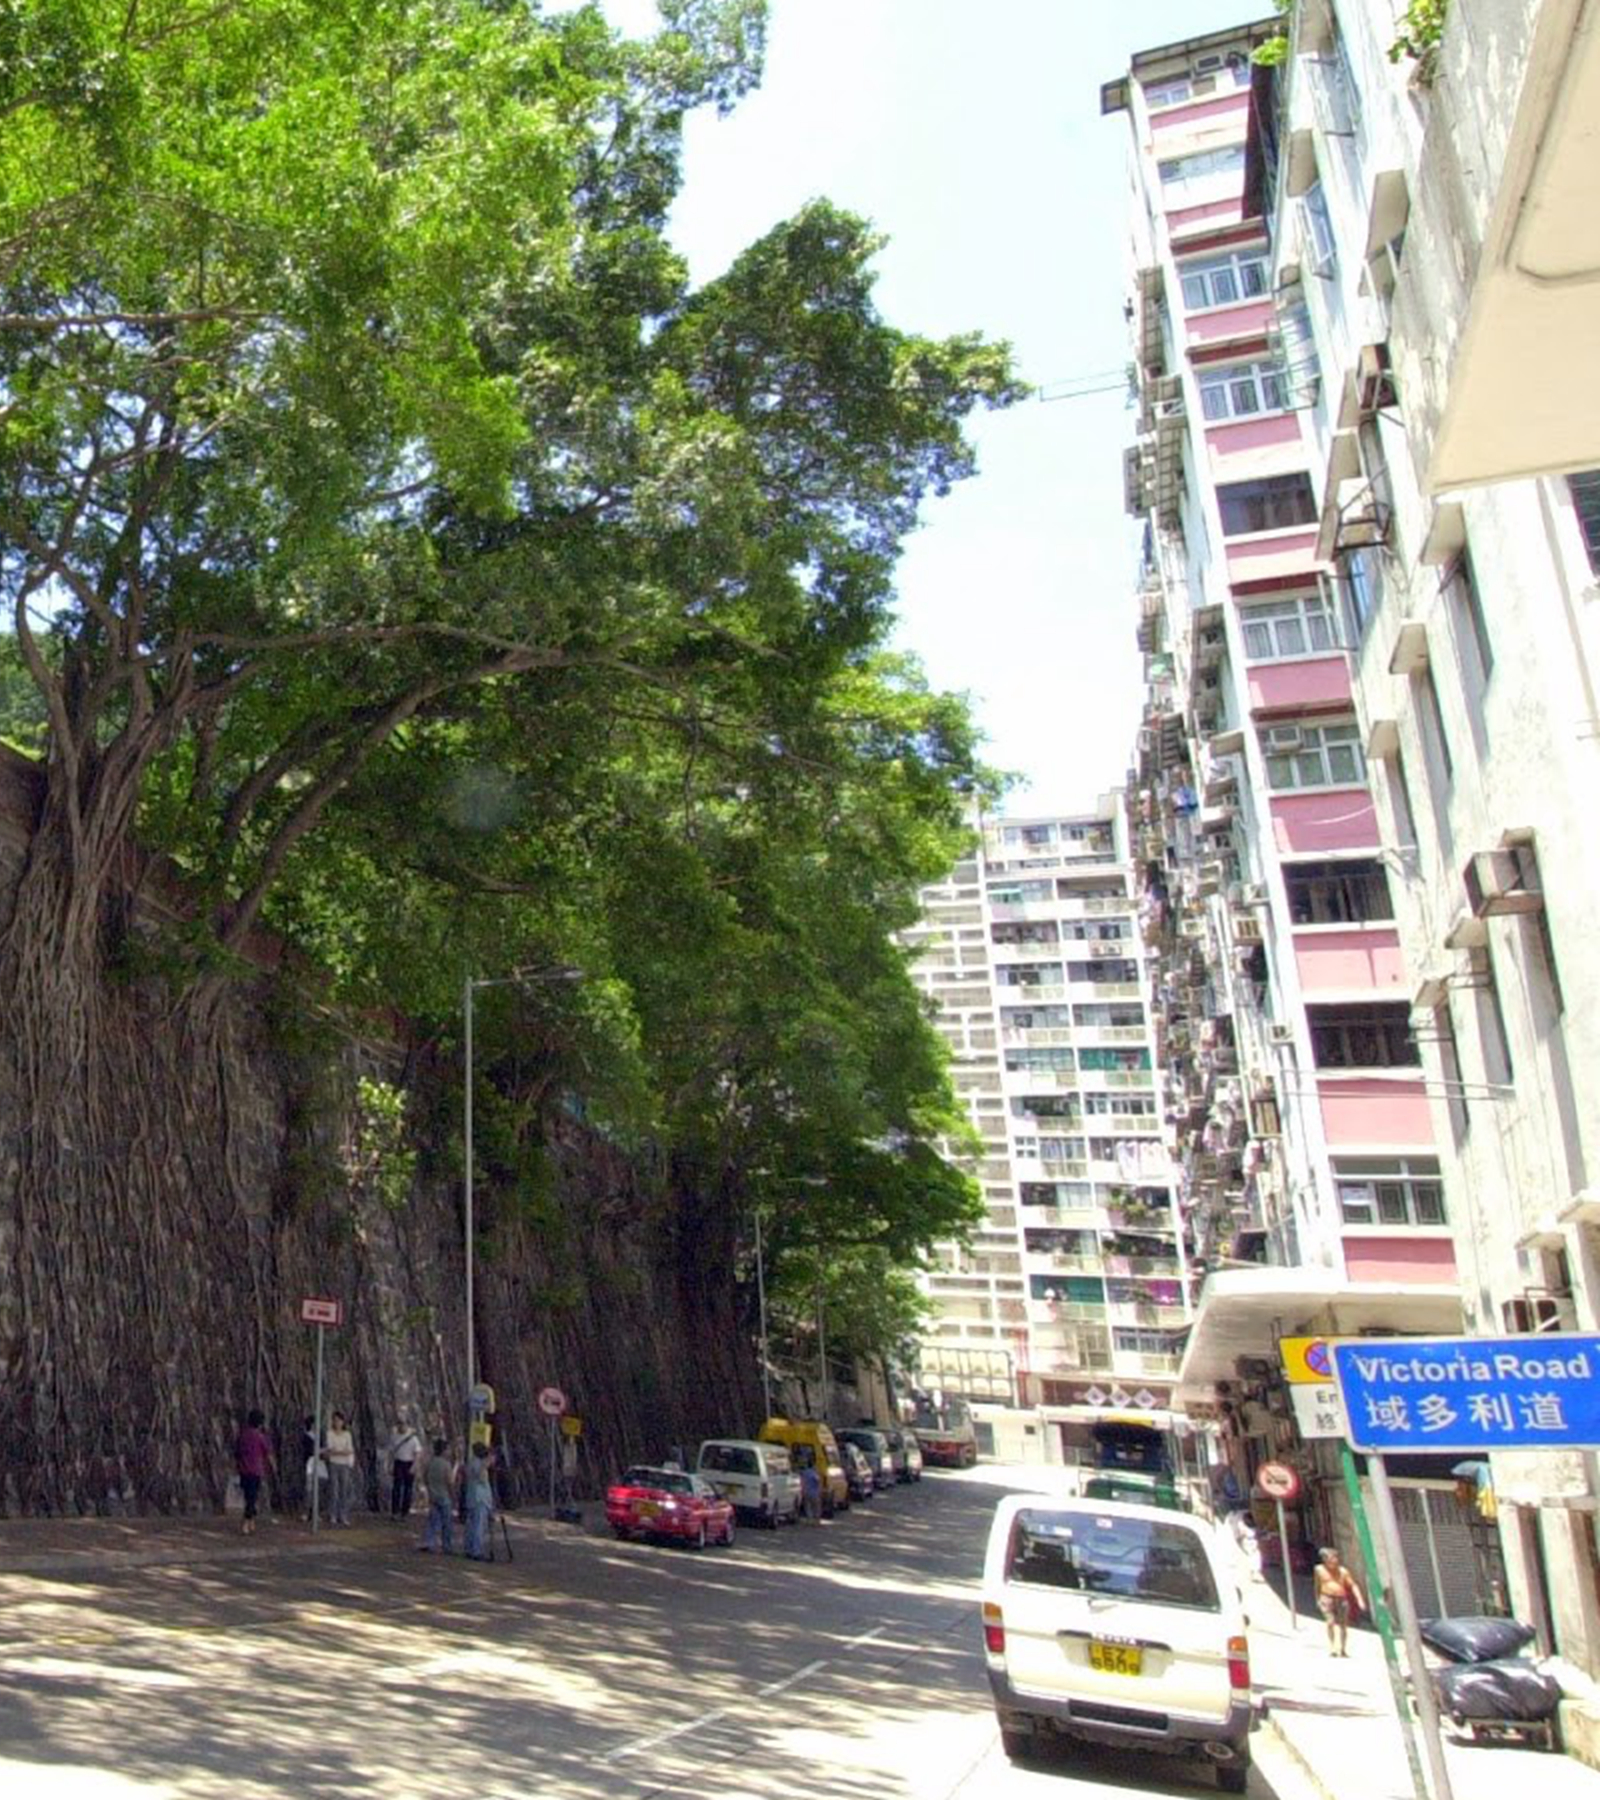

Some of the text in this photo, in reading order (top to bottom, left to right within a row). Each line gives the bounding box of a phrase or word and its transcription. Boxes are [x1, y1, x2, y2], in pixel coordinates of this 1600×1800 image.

[1356, 1353, 1592, 1382] Victoria Road
[1367, 1392, 1568, 1432] 域多利道
